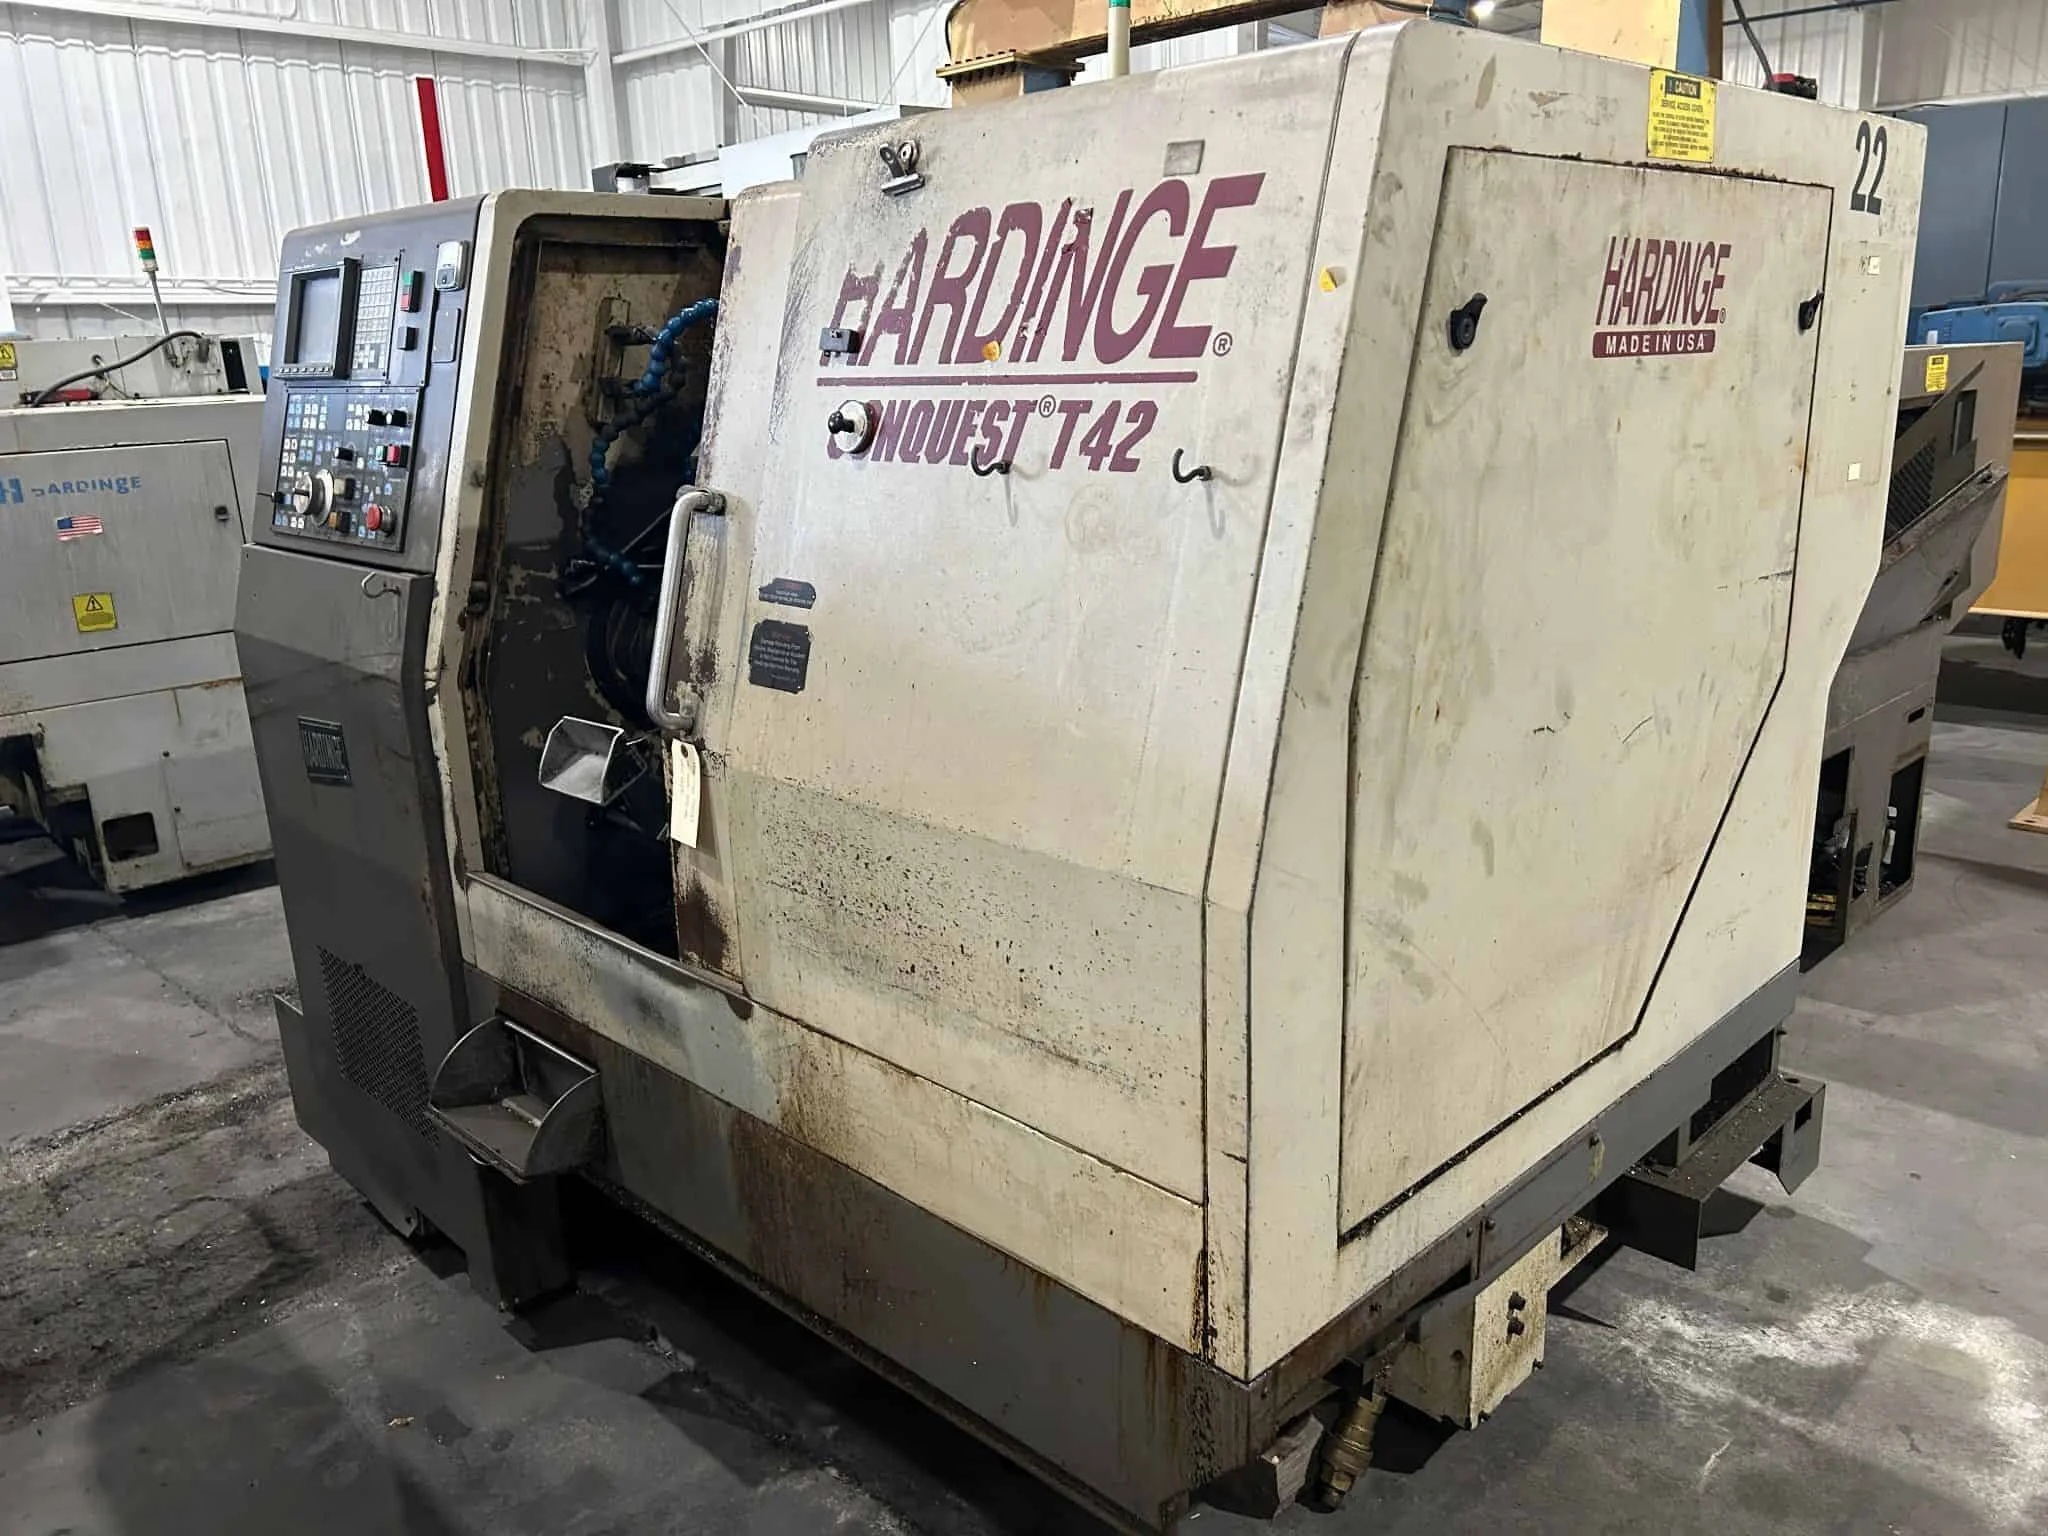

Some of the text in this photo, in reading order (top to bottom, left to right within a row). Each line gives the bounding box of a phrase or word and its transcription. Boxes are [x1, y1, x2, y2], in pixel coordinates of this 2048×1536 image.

[1850, 120, 1888, 215] 22
[1605, 333, 1705, 354] MADE IN USA
[1048, 400, 1159, 473] T42
